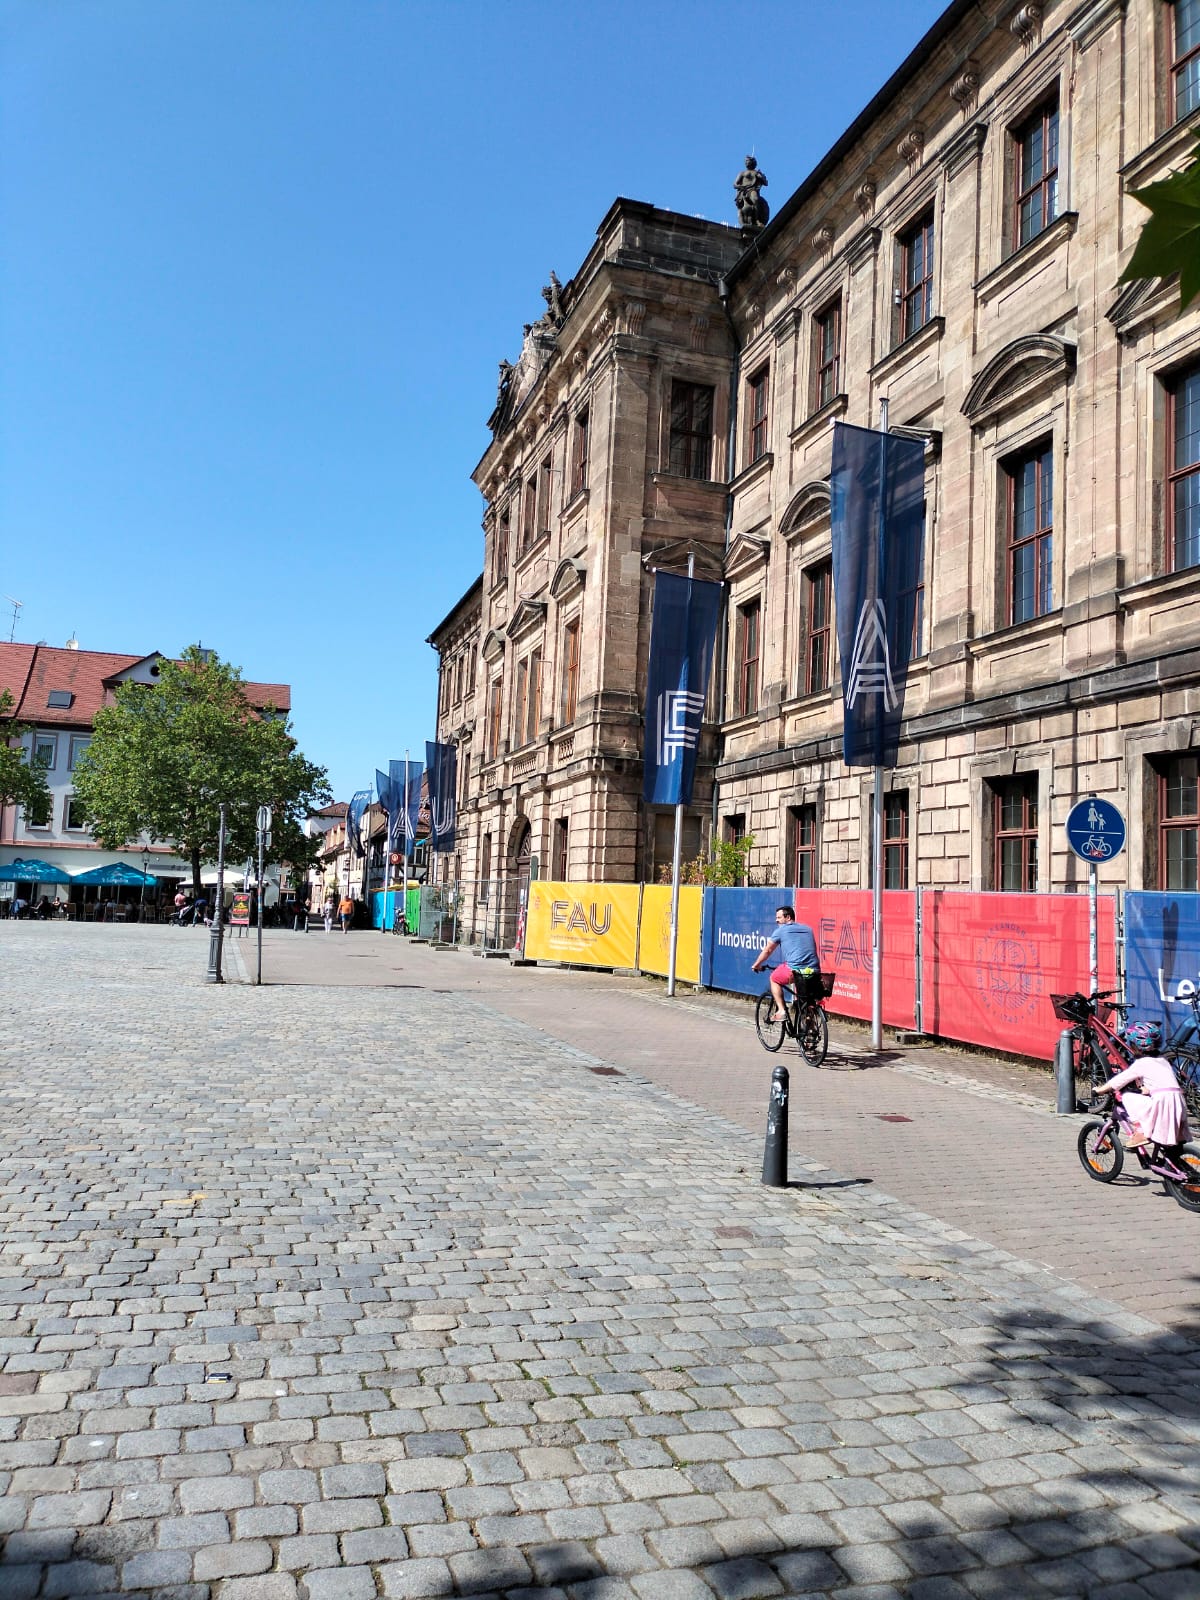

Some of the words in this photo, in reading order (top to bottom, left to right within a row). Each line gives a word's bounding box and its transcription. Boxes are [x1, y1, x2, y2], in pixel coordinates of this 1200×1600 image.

[846, 599, 899, 712] A
[656, 690, 705, 766] F
[391, 807, 415, 840] A
[431, 797, 454, 836] U
[551, 900, 612, 935] FAU
[718, 927, 770, 951] Innovatio
[1158, 968, 1200, 1006] Le
